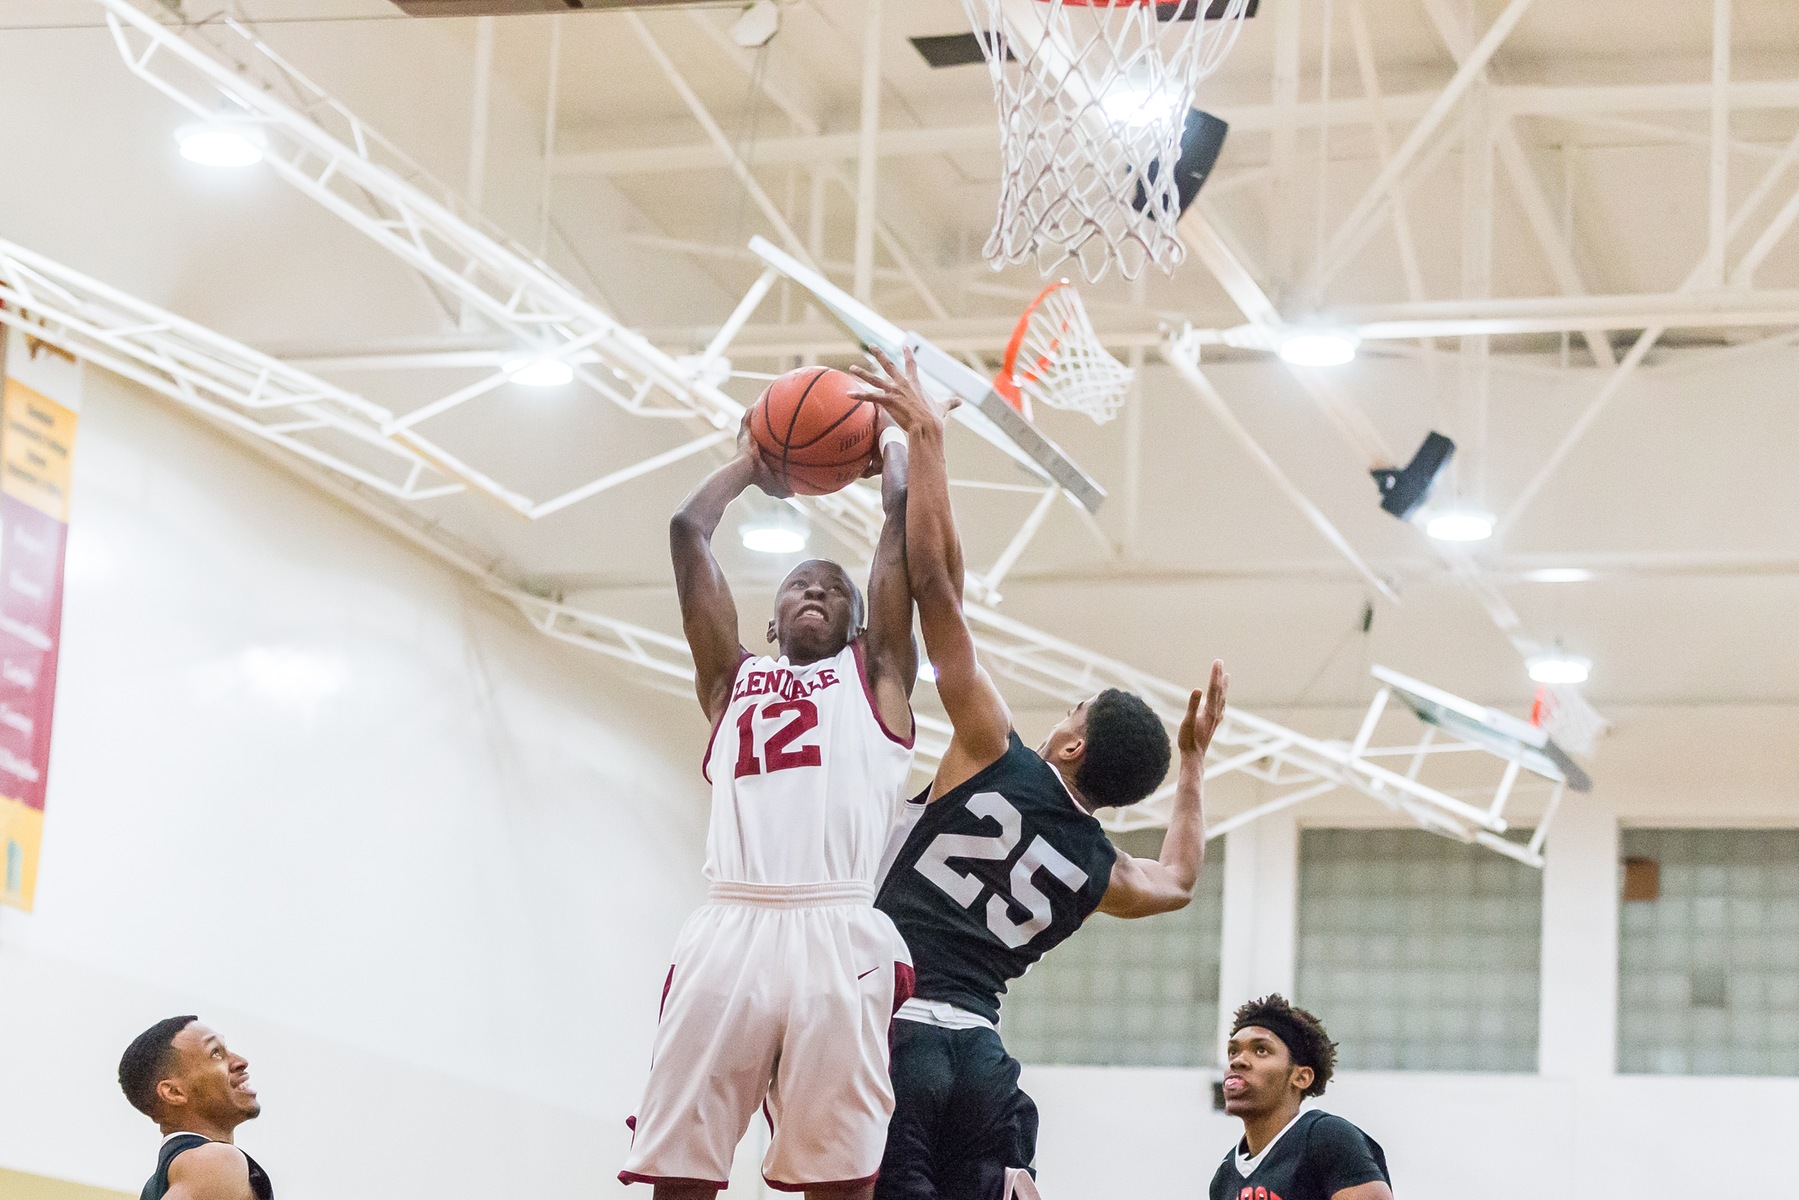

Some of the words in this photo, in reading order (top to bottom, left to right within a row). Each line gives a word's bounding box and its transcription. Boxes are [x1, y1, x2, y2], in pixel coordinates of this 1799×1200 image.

[733, 669, 840, 702] LENDALE
[734, 699, 821, 780] 12
[913, 791, 1089, 949] 25
